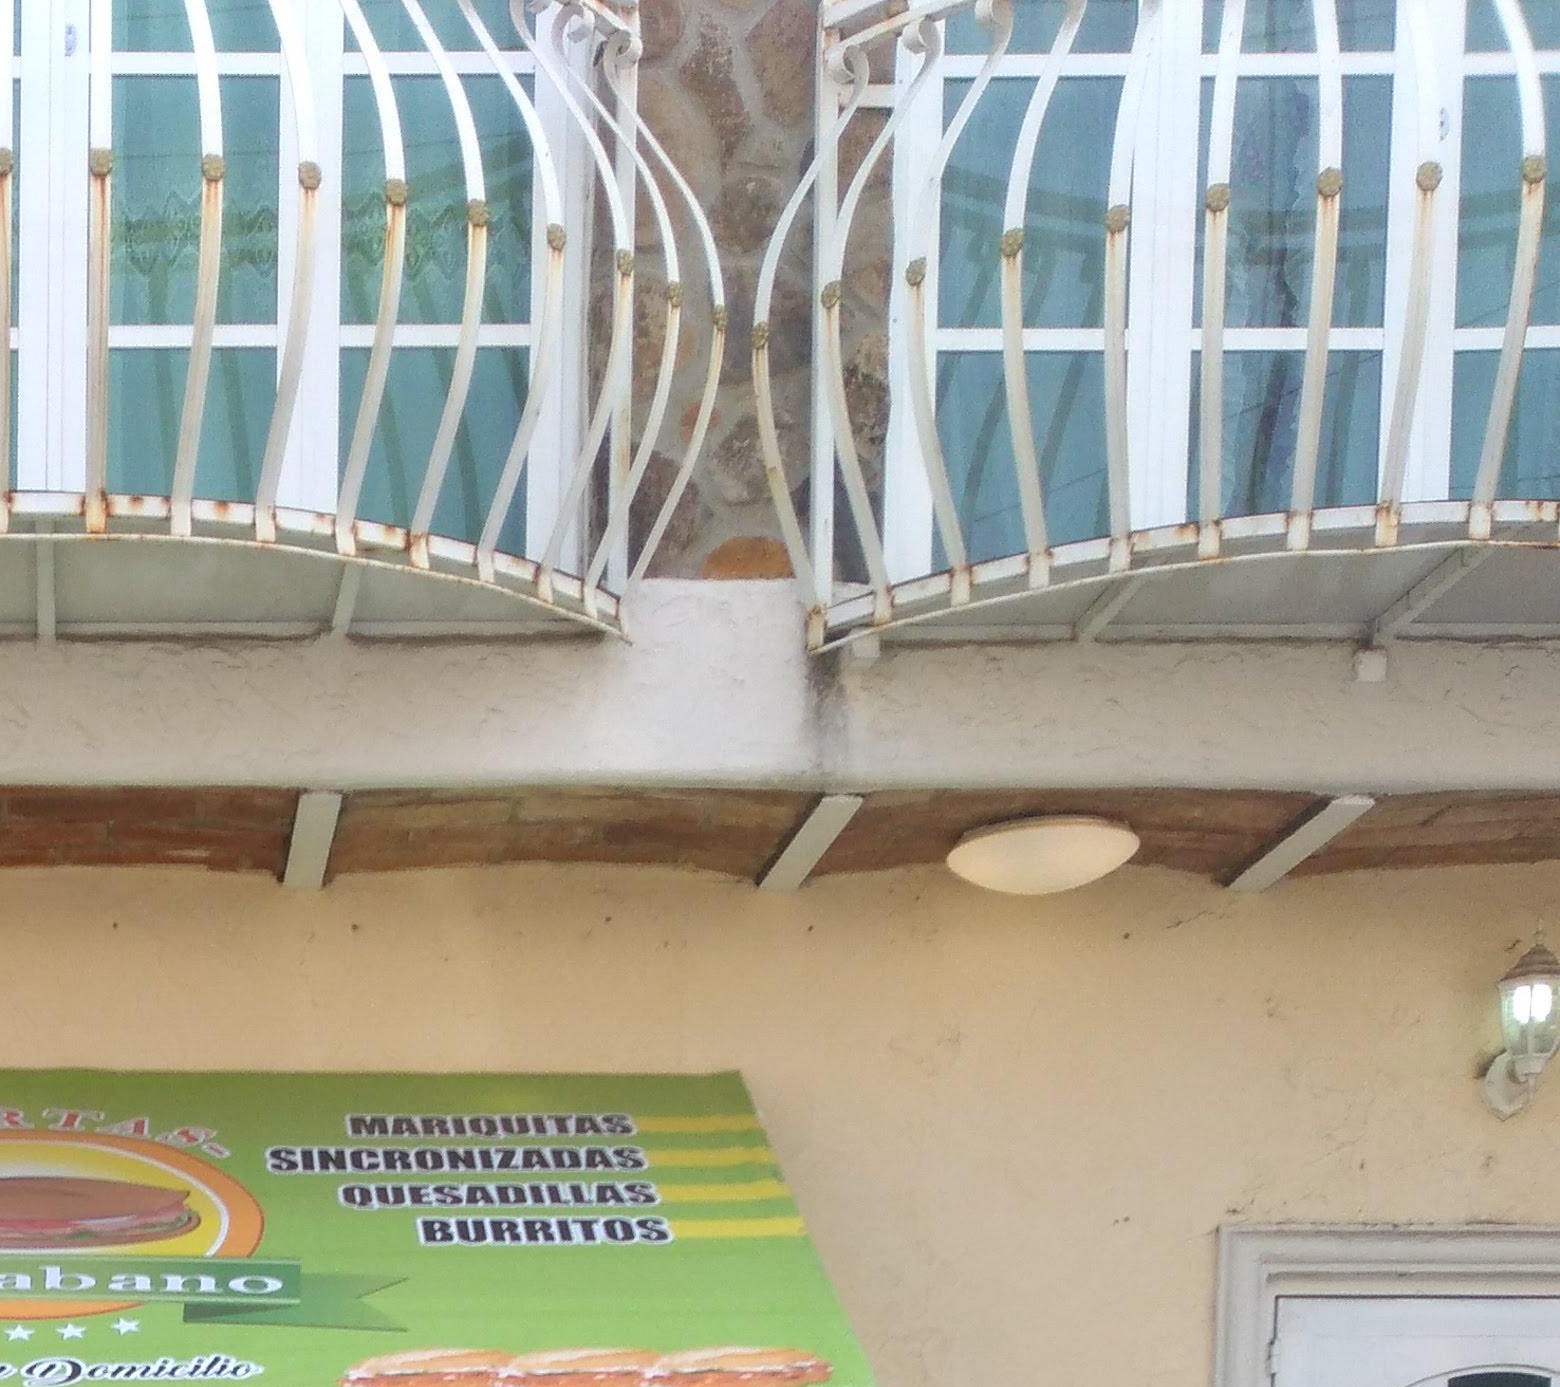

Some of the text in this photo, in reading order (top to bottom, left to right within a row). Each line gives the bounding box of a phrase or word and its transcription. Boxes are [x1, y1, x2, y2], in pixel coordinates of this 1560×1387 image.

[345, 1113, 637, 1138] MARIQUITAS
[265, 1146, 649, 1174] SINCRONIZADAS
[339, 1182, 660, 1209] QUESADILLAS
[417, 1216, 675, 1245] BURRITOS
